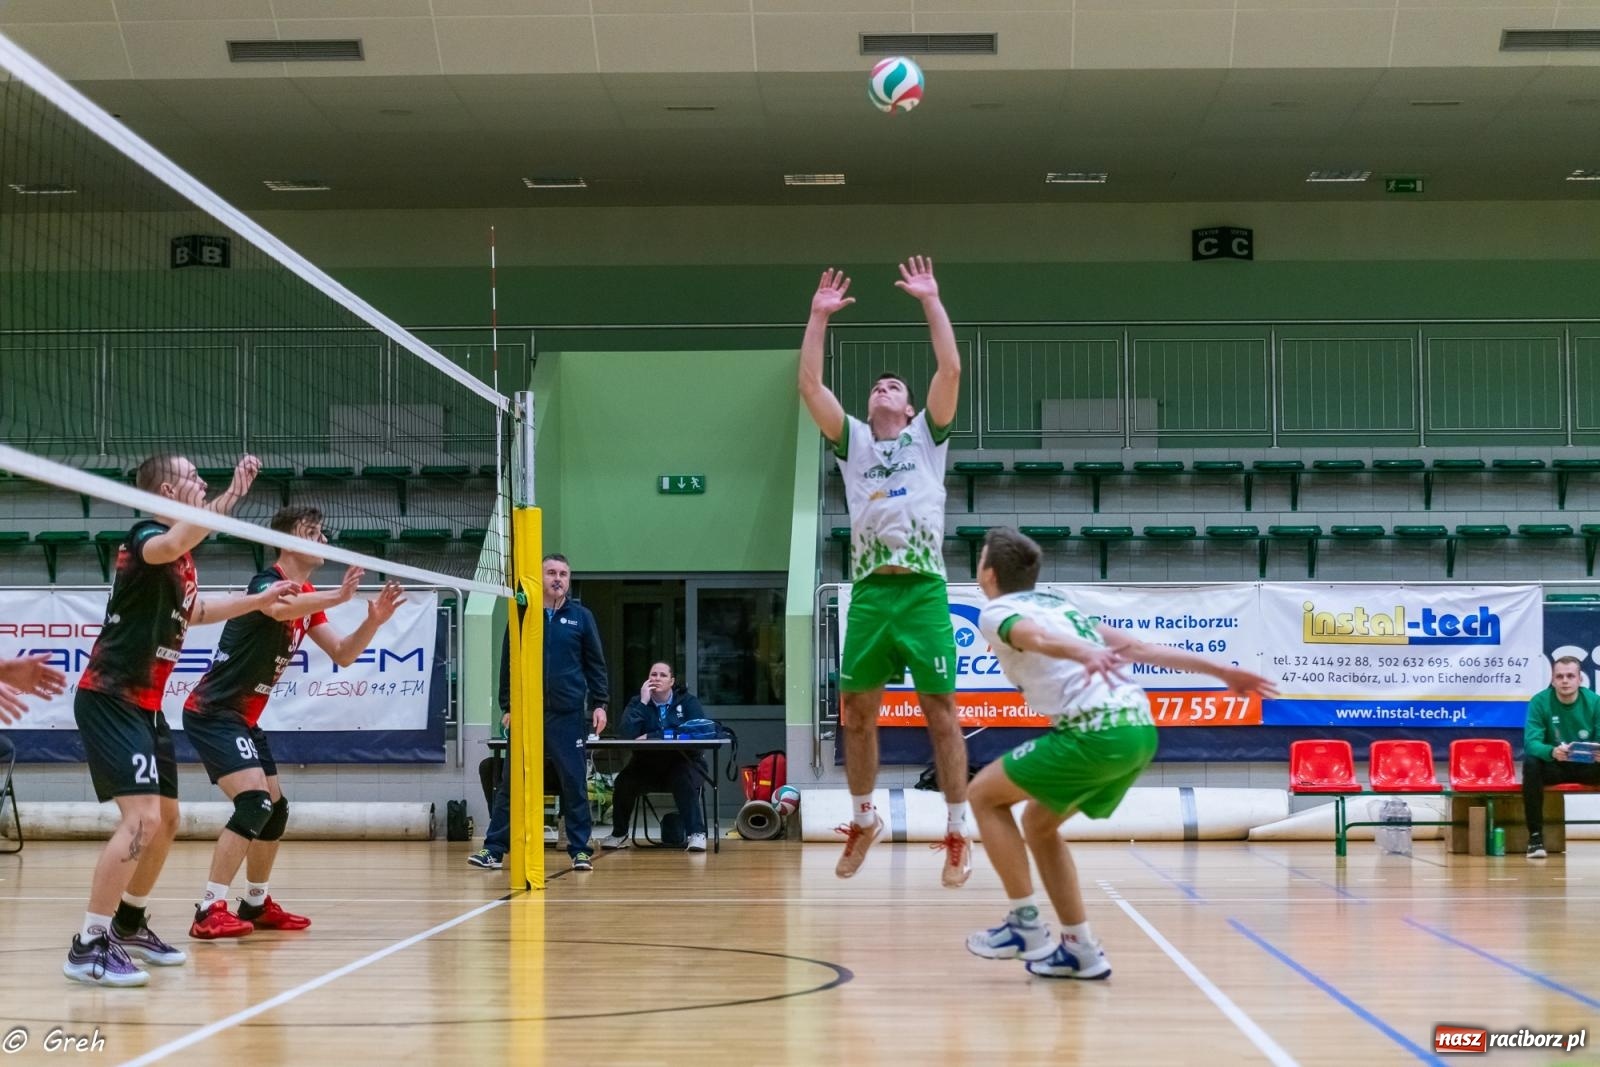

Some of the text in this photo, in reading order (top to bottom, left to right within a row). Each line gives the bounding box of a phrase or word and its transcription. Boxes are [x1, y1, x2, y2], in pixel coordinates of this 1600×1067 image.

[202, 246, 223, 264] B
[1198, 238, 1218, 256] C
[1231, 237, 1249, 256] C
[1138, 619, 1150, 629] w
[1155, 615, 1238, 630] Raciborzu:
[1303, 601, 1500, 645] instal-tech
[1208, 639, 1226, 652] 69
[1273, 655, 1292, 668] tel.
[1294, 656, 1308, 666] 32
[1312, 656, 1334, 667] 414
[1337, 656, 1351, 667] 92
[1378, 657, 1399, 667] 502
[1402, 657, 1424, 667] 632
[1459, 657, 1480, 667] 606
[1484, 657, 1504, 668] 363
[1507, 657, 1529, 668] 647
[1281, 671, 1521, 684] 47-400 Racibórz, ul. J. von Eichendorffa 2
[308, 681, 368, 697] OLESNO
[371, 682, 397, 696] 94,9
[400, 680, 425, 696] FM
[1157, 697, 1250, 720] 77 55 77
[1336, 706, 1467, 723] www.instal-tech.pl
[132, 753, 159, 784] 24
